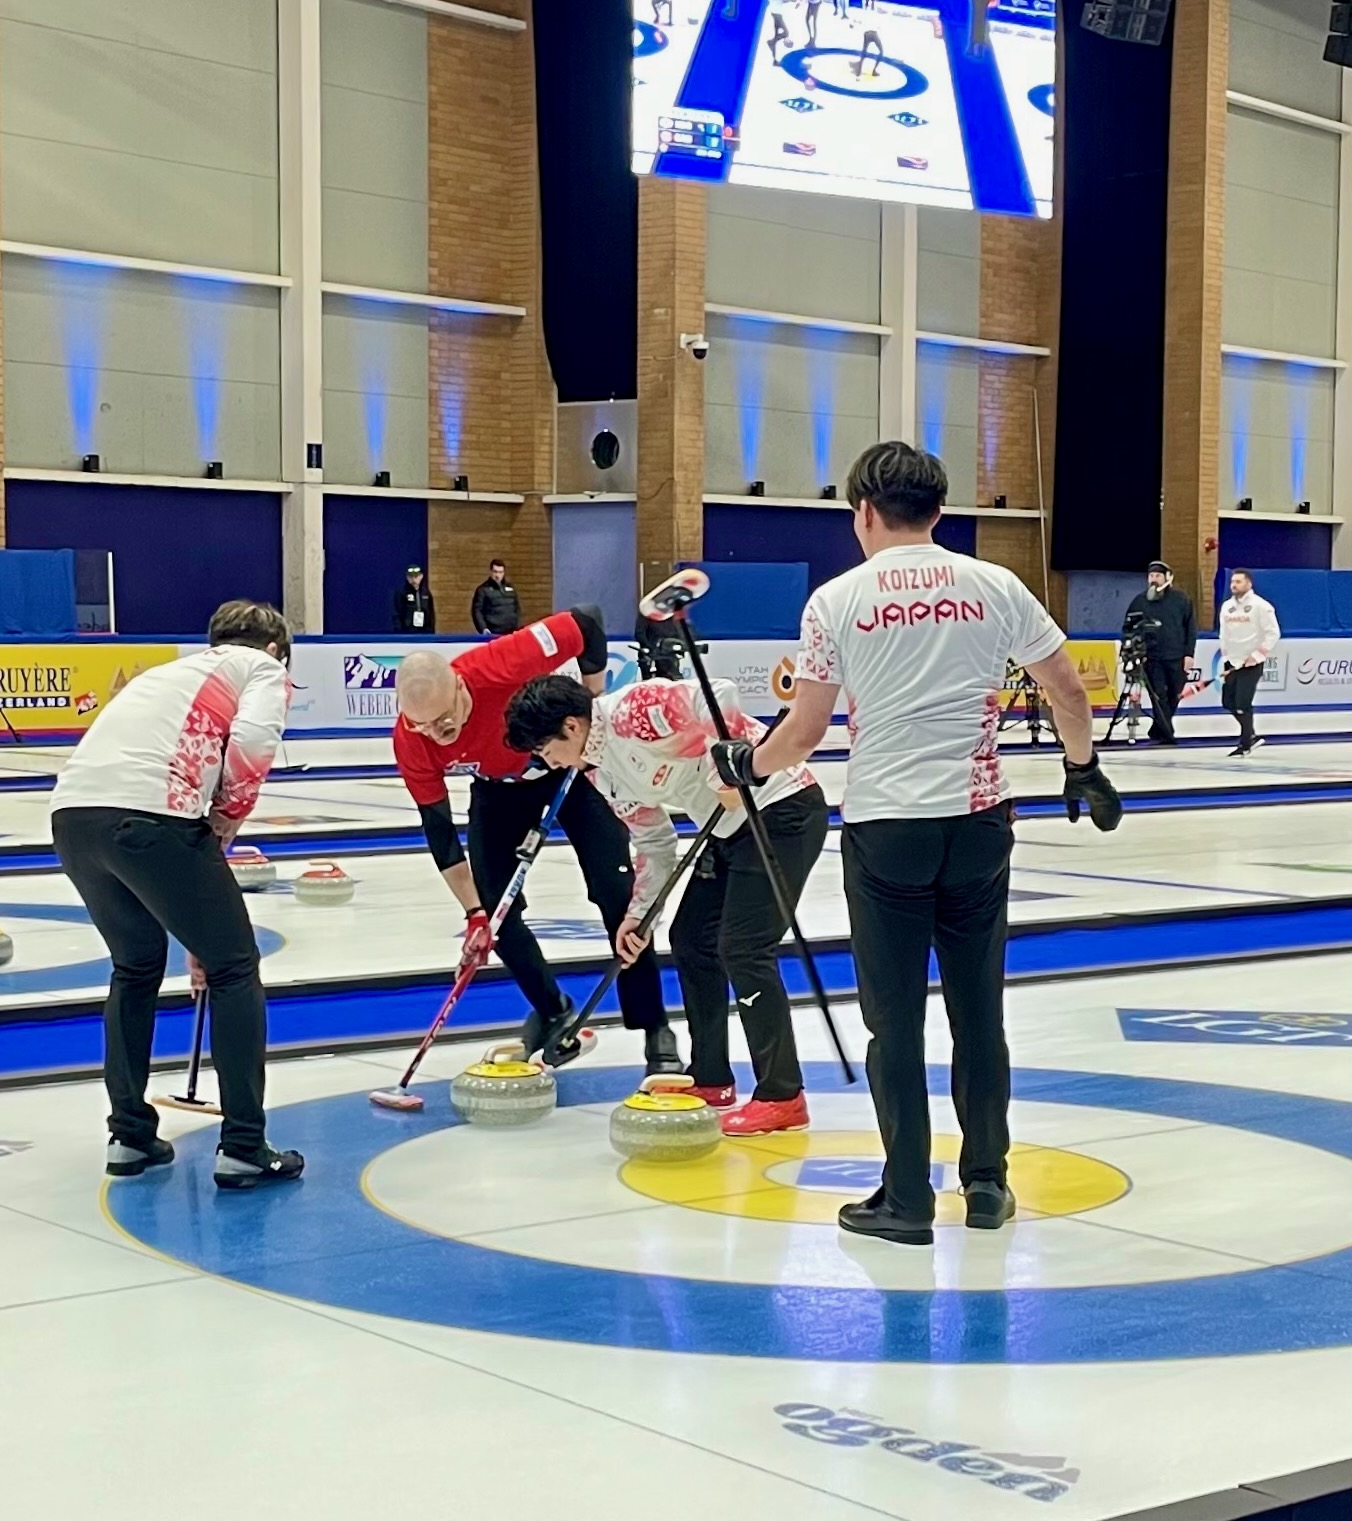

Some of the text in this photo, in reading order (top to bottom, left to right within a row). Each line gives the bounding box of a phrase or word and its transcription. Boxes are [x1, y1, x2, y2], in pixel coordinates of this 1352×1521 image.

[877, 565, 956, 592] KOIZUMI
[856, 599, 984, 632] JAPAN
[738, 665, 769, 675] UTAH
[346, 693, 393, 717] WEBER
[773, 1402, 1070, 1502] ogden
